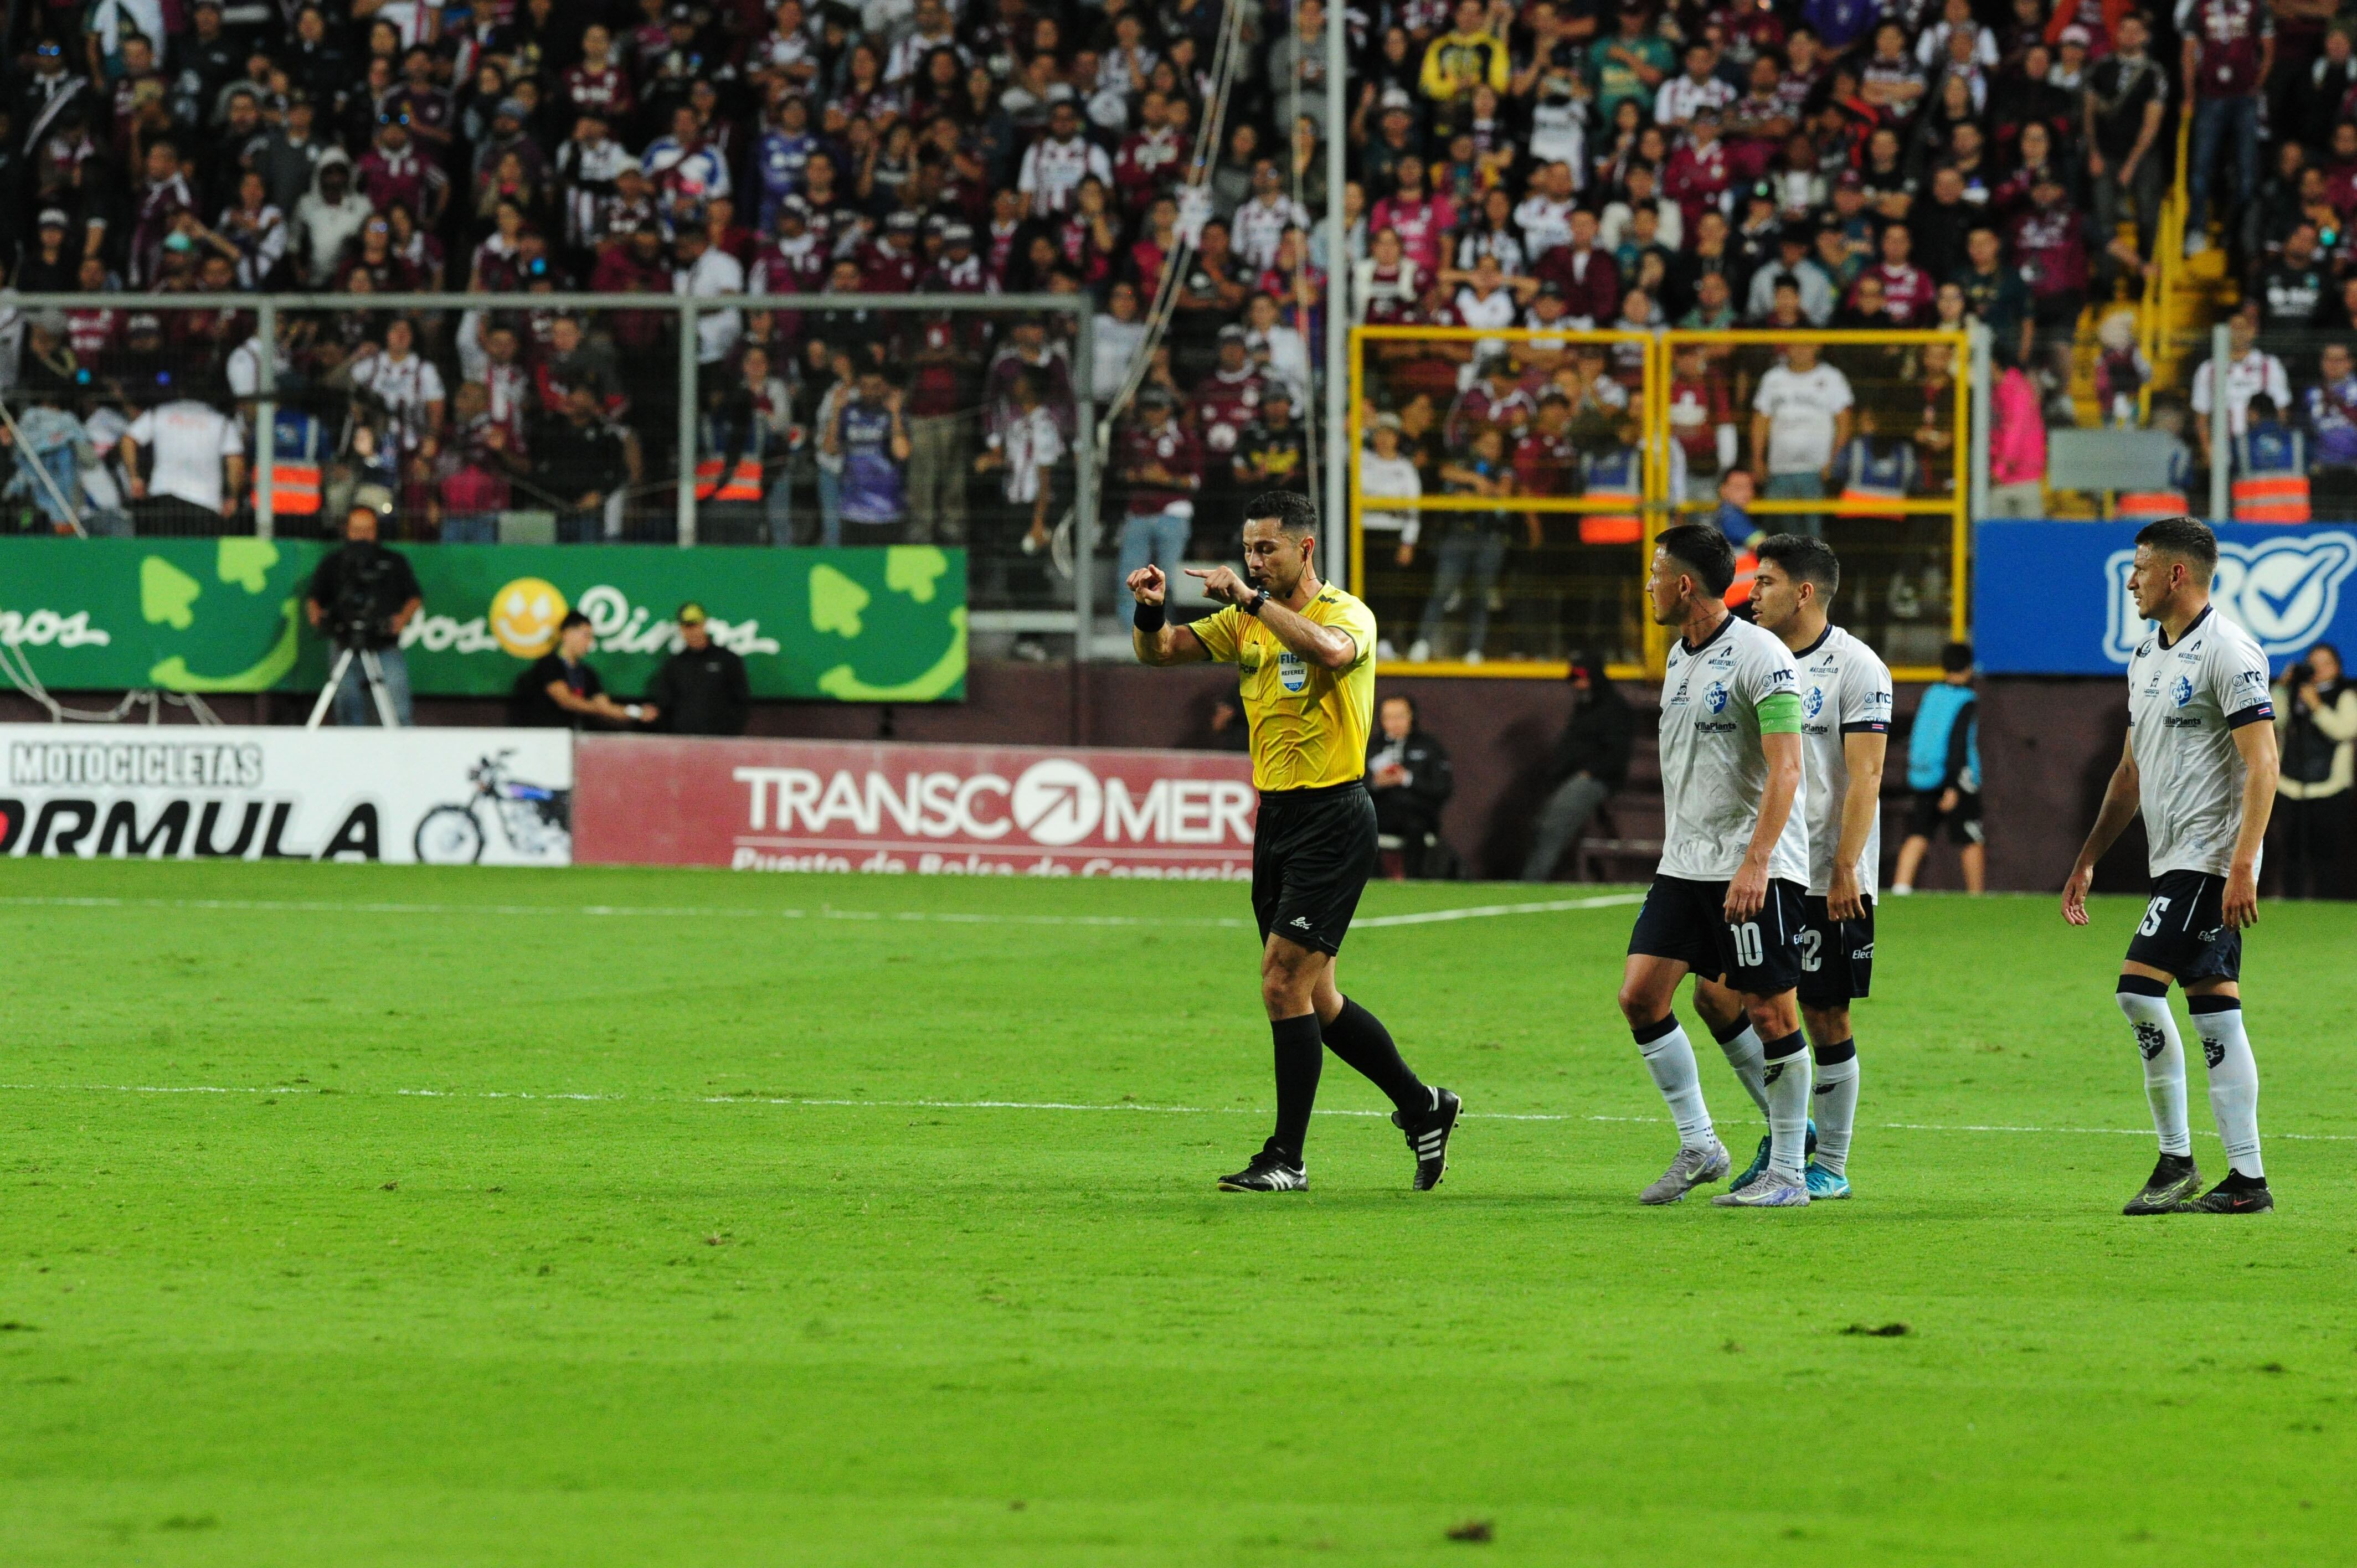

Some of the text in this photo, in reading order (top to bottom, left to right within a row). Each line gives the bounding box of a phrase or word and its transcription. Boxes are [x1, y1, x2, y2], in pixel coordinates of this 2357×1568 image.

[11, 742, 263, 786] MOTOCICLETAS
[732, 758, 1255, 845] TRANSCOMER
[1731, 922, 1763, 967] 10
